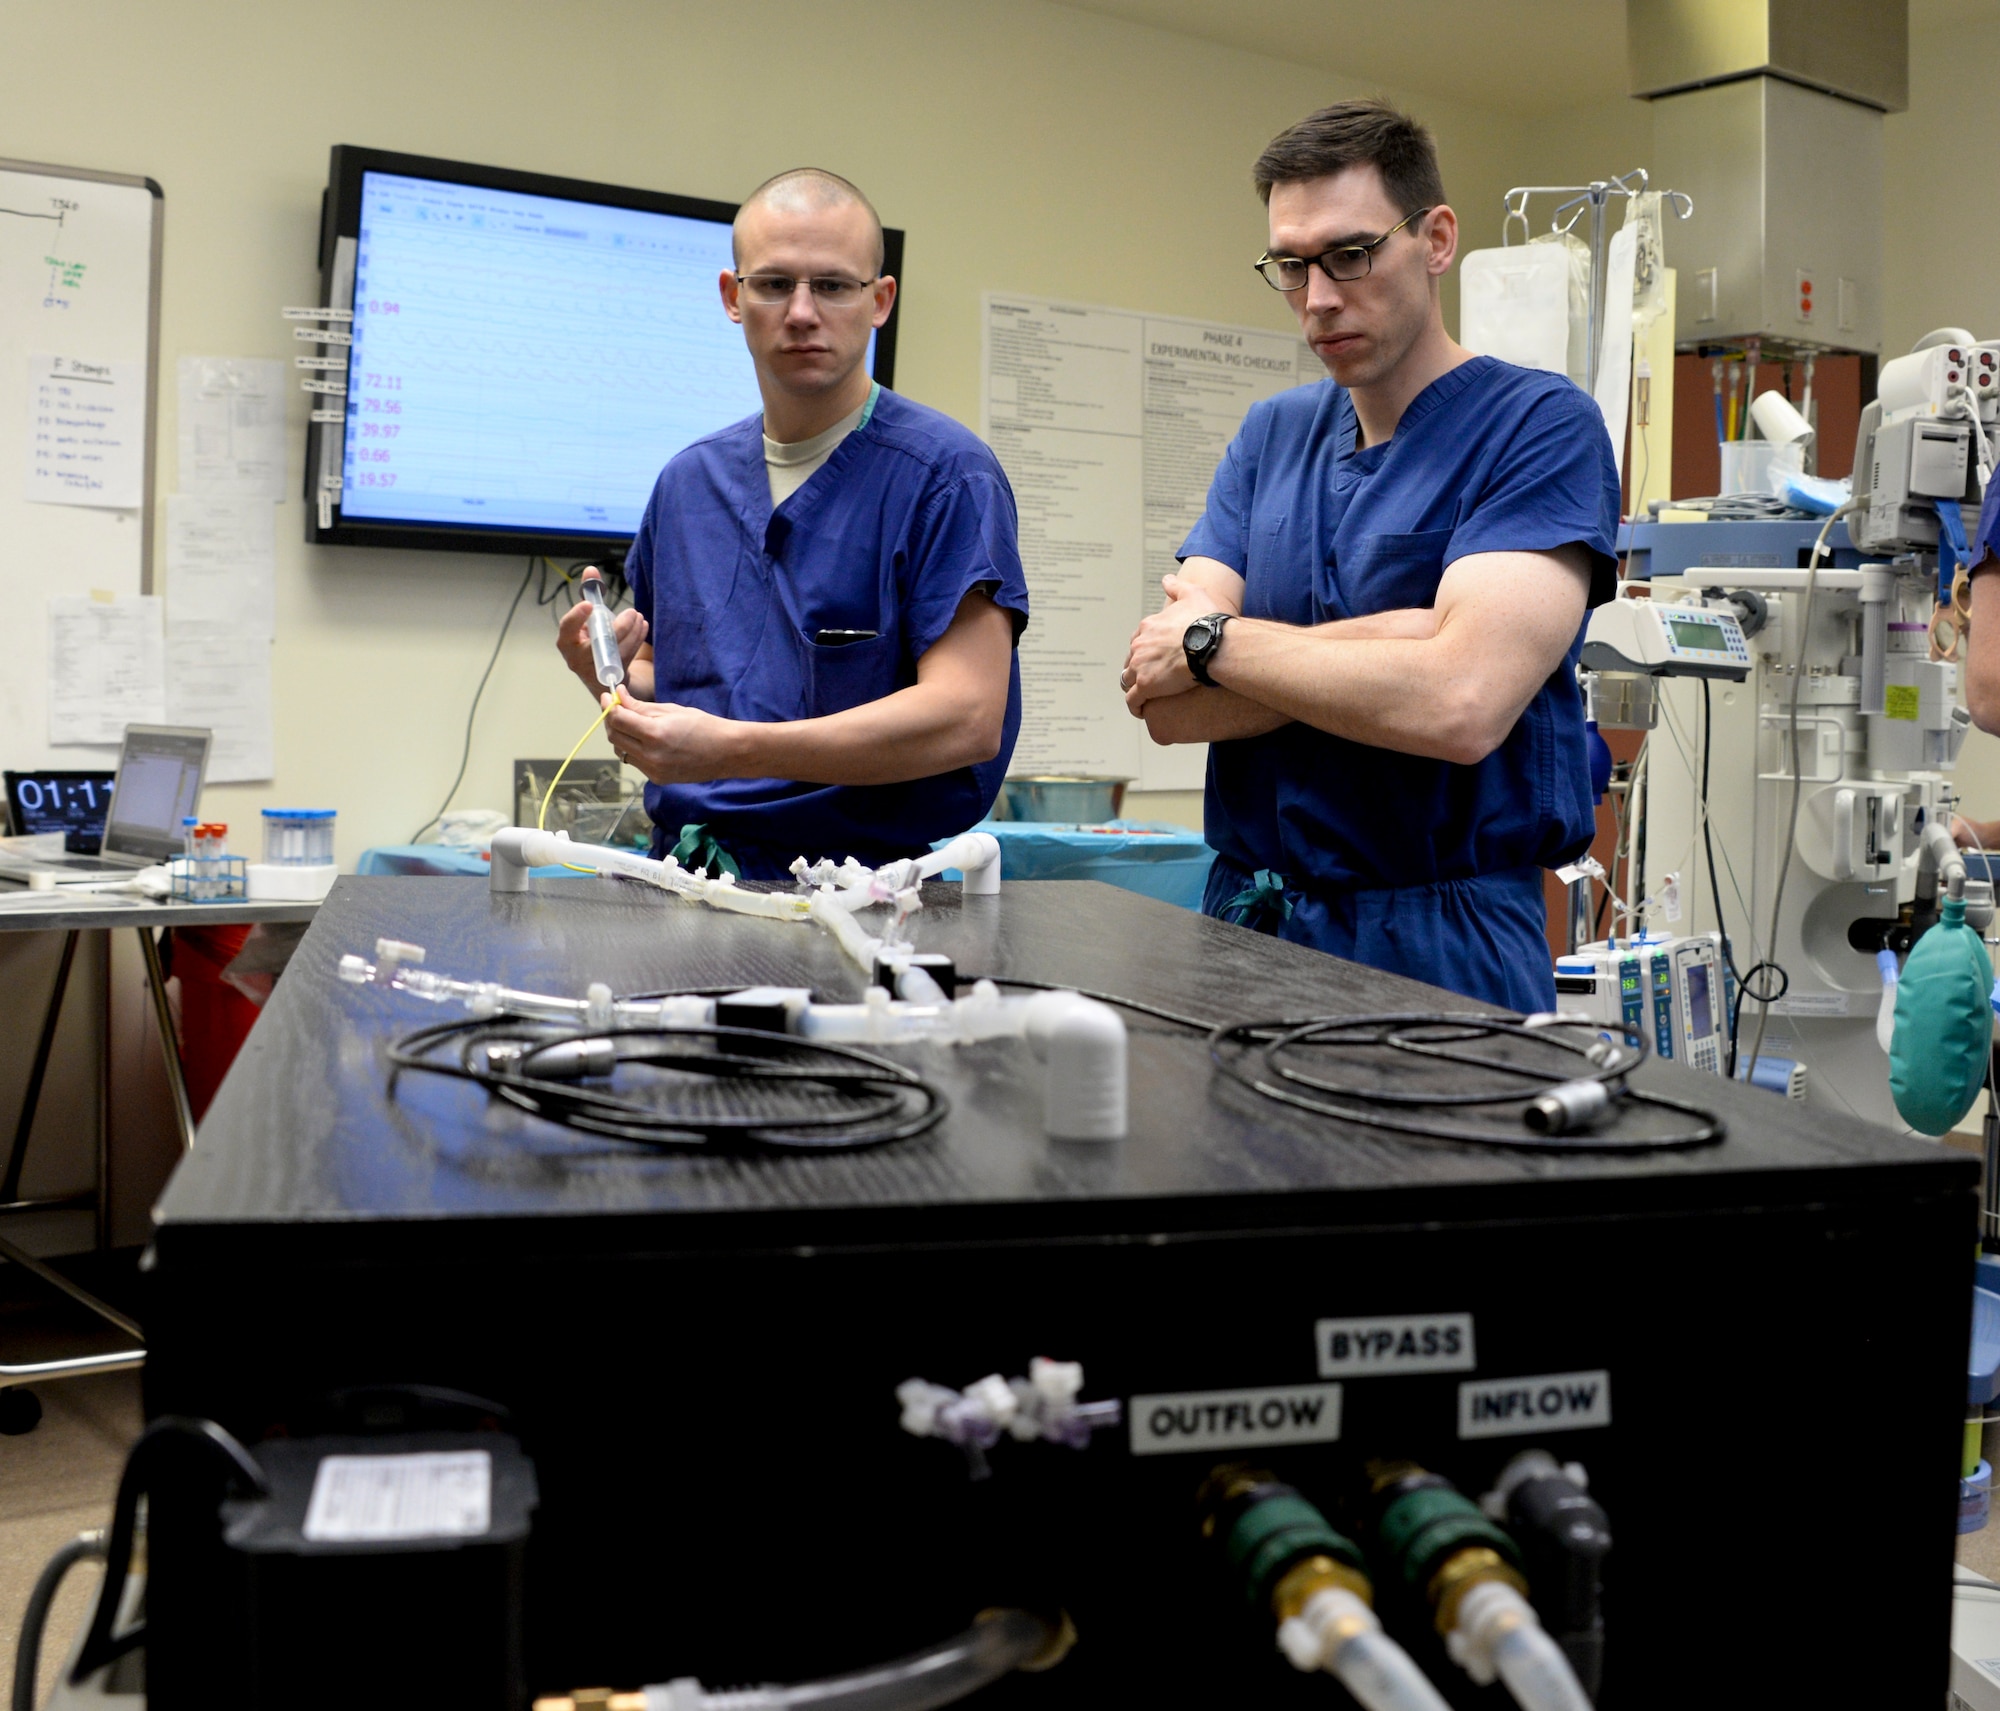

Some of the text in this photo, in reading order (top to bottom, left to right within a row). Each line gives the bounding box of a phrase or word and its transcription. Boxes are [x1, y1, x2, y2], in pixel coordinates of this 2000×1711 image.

[368, 300, 400, 315] 0.94
[1203, 331, 1243, 347] PHASE 4
[1151, 343, 1291, 372] EXPERIMENTAL PIG CHECKLIST
[365, 373, 402, 390] 72.11
[364, 398, 402, 415] 79.56
[361, 423, 400, 439] 39.97
[358, 447, 390, 463] 0.66
[358, 472, 397, 488] 19.57
[1329, 1325, 1463, 1361] BYPASS
[1472, 1383, 1598, 1422] INFLOW
[1149, 1397, 1324, 1438] OUTFLOW
